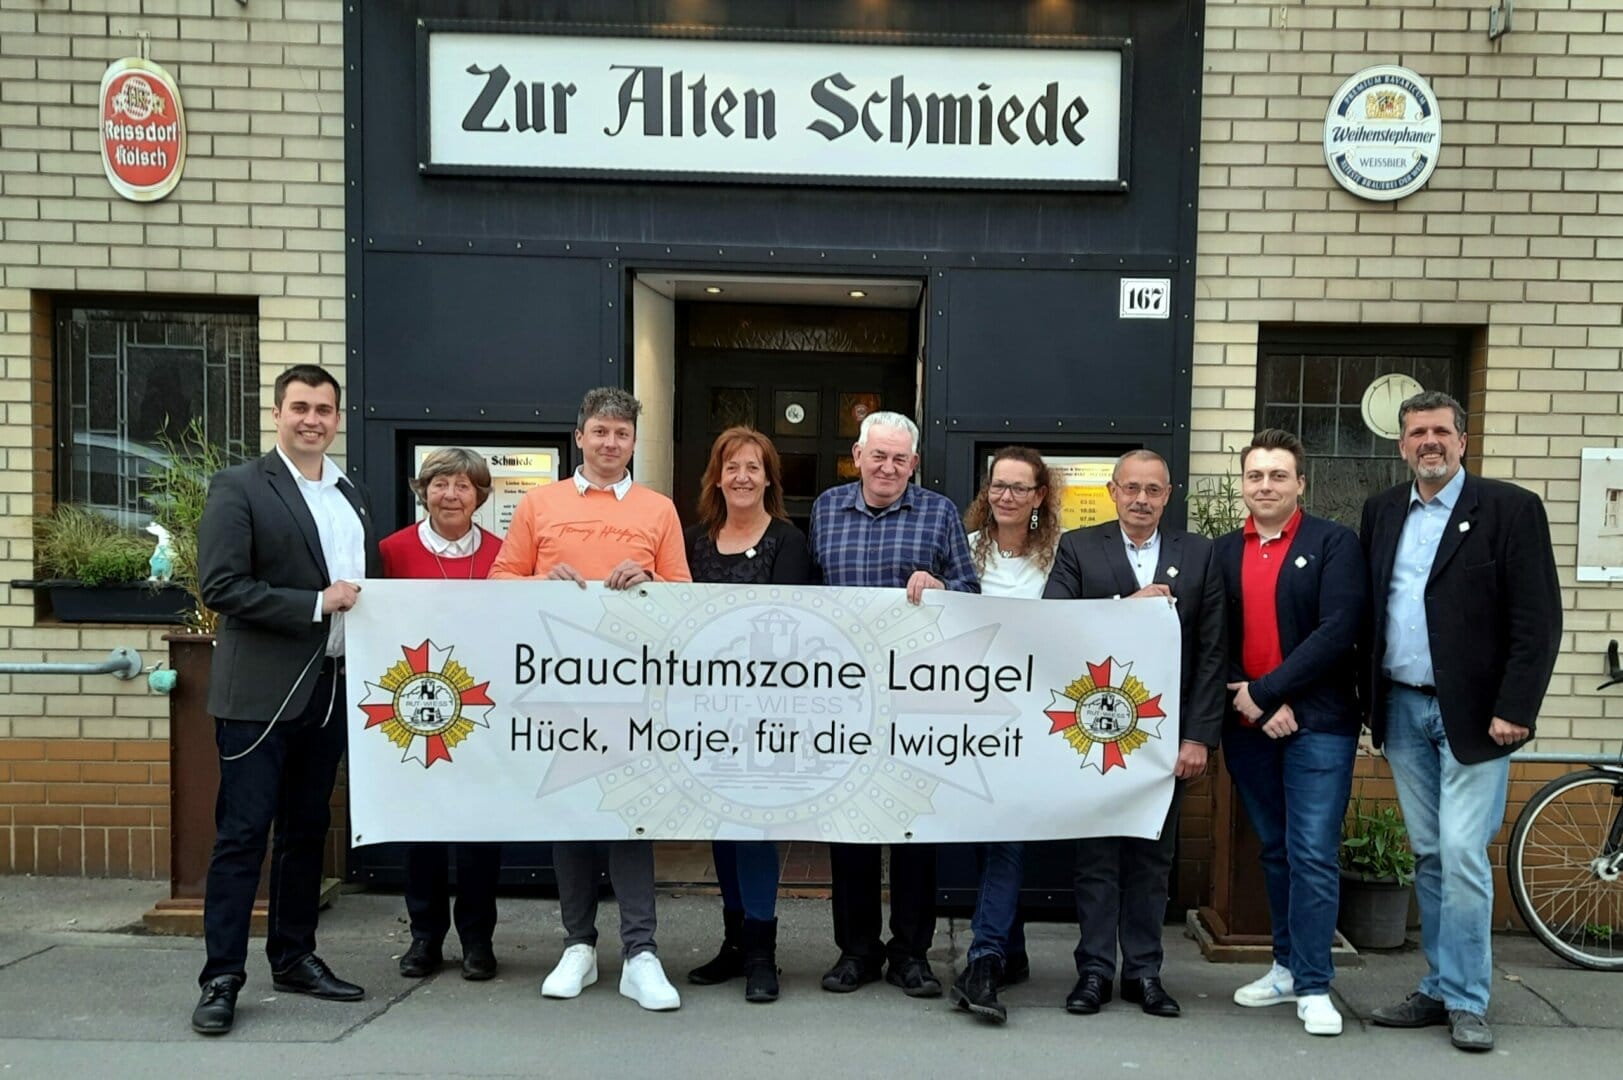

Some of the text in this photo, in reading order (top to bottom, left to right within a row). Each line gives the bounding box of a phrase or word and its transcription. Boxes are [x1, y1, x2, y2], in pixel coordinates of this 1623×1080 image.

[1344, 75, 1382, 104] PREMIUM
[461, 63, 1090, 150] Zur Alten Schmiede
[105, 120, 177, 142] Reissdorf
[1332, 126, 1436, 145] Weihenstephaner
[115, 144, 167, 169] Kölsch
[1359, 157, 1407, 168] WEISSBIER
[1129, 287, 1165, 310] 167
[491, 455, 533, 466] Schmiede
[515, 643, 1034, 703] Brauchtumszone Langel
[511, 717, 1023, 766] Hück, Morje, für die Iwigkeit
